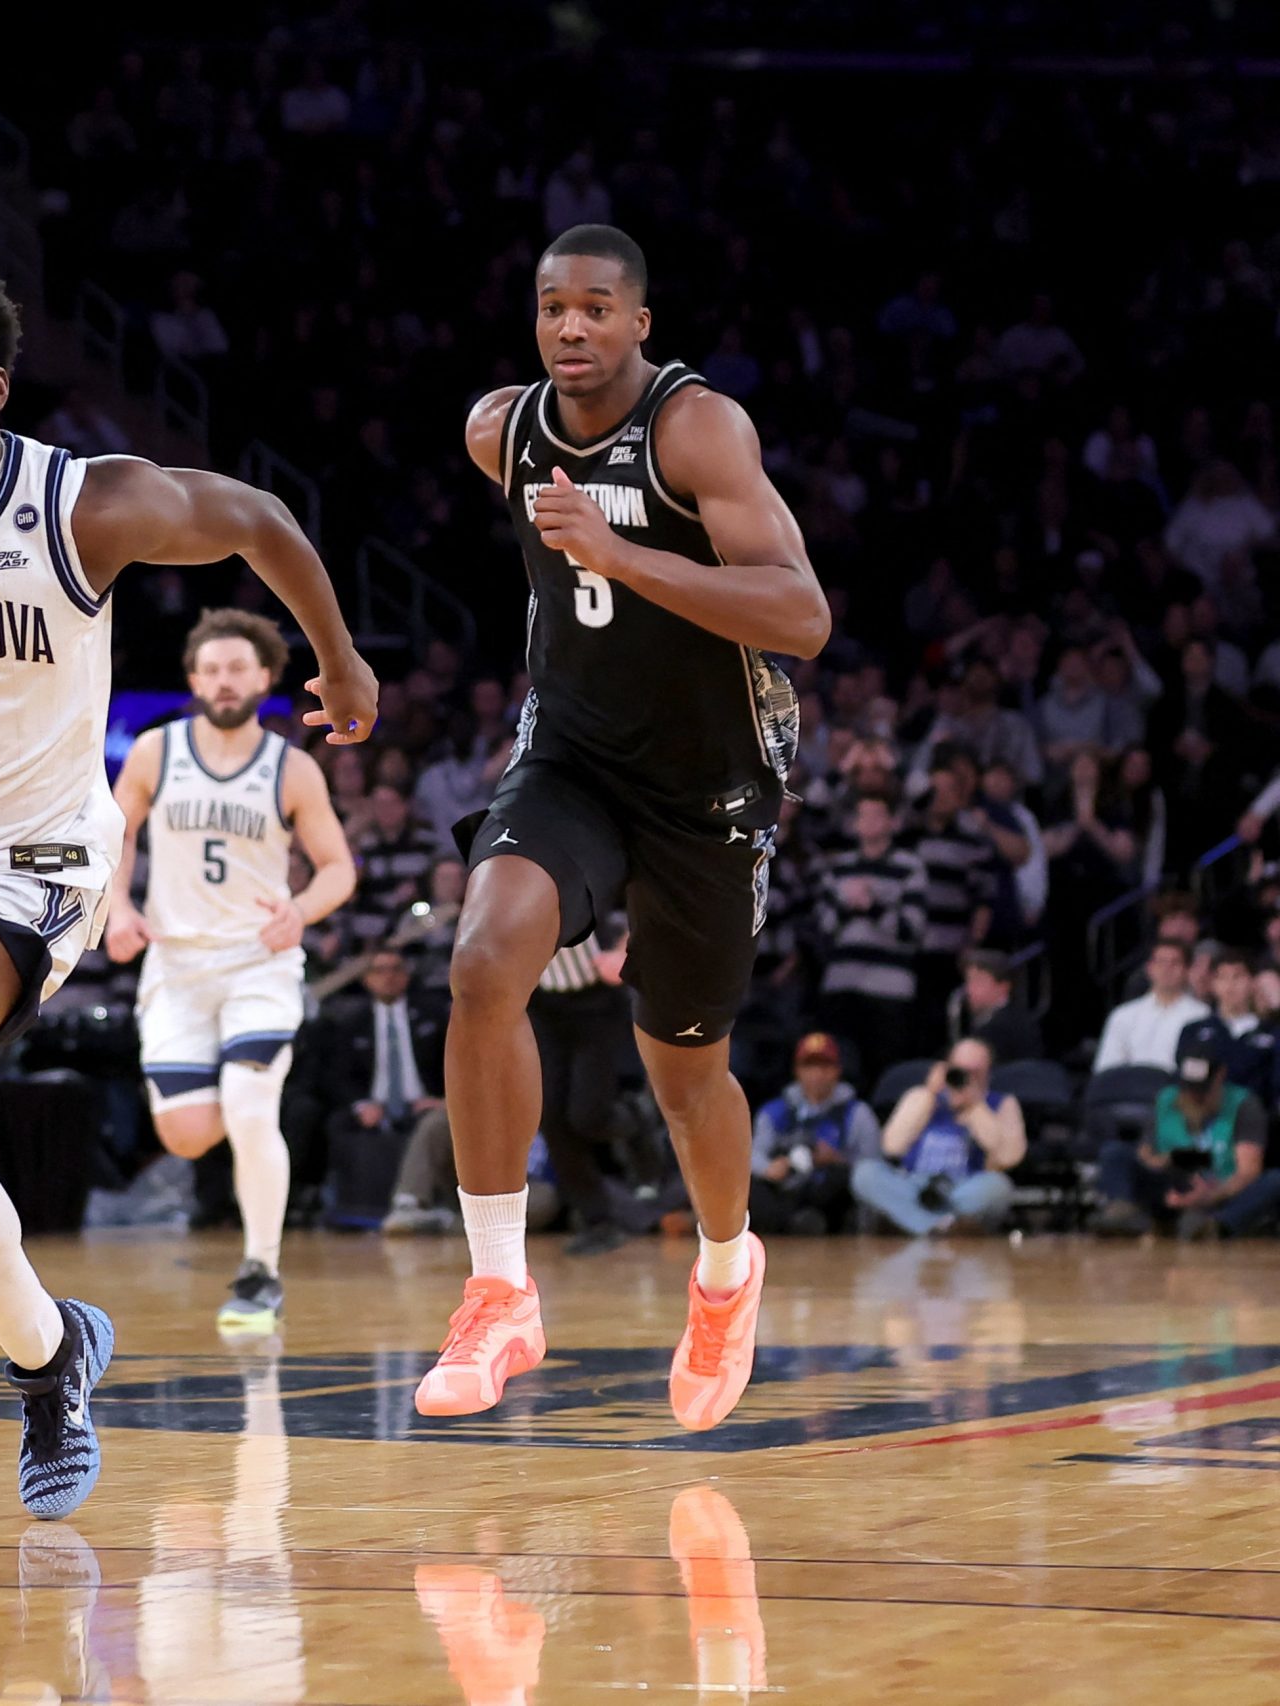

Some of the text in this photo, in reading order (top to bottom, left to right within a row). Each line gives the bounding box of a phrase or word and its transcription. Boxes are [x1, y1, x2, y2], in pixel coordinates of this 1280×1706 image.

[621, 434, 644, 442] ANGE
[609, 453, 637, 461] EAST
[523, 483, 649, 527] GTOWN
[17, 511, 35, 525] GHR
[166, 799, 266, 842] VILLANOVA
[65, 850, 78, 860] 48
[204, 838, 227, 884] 5
